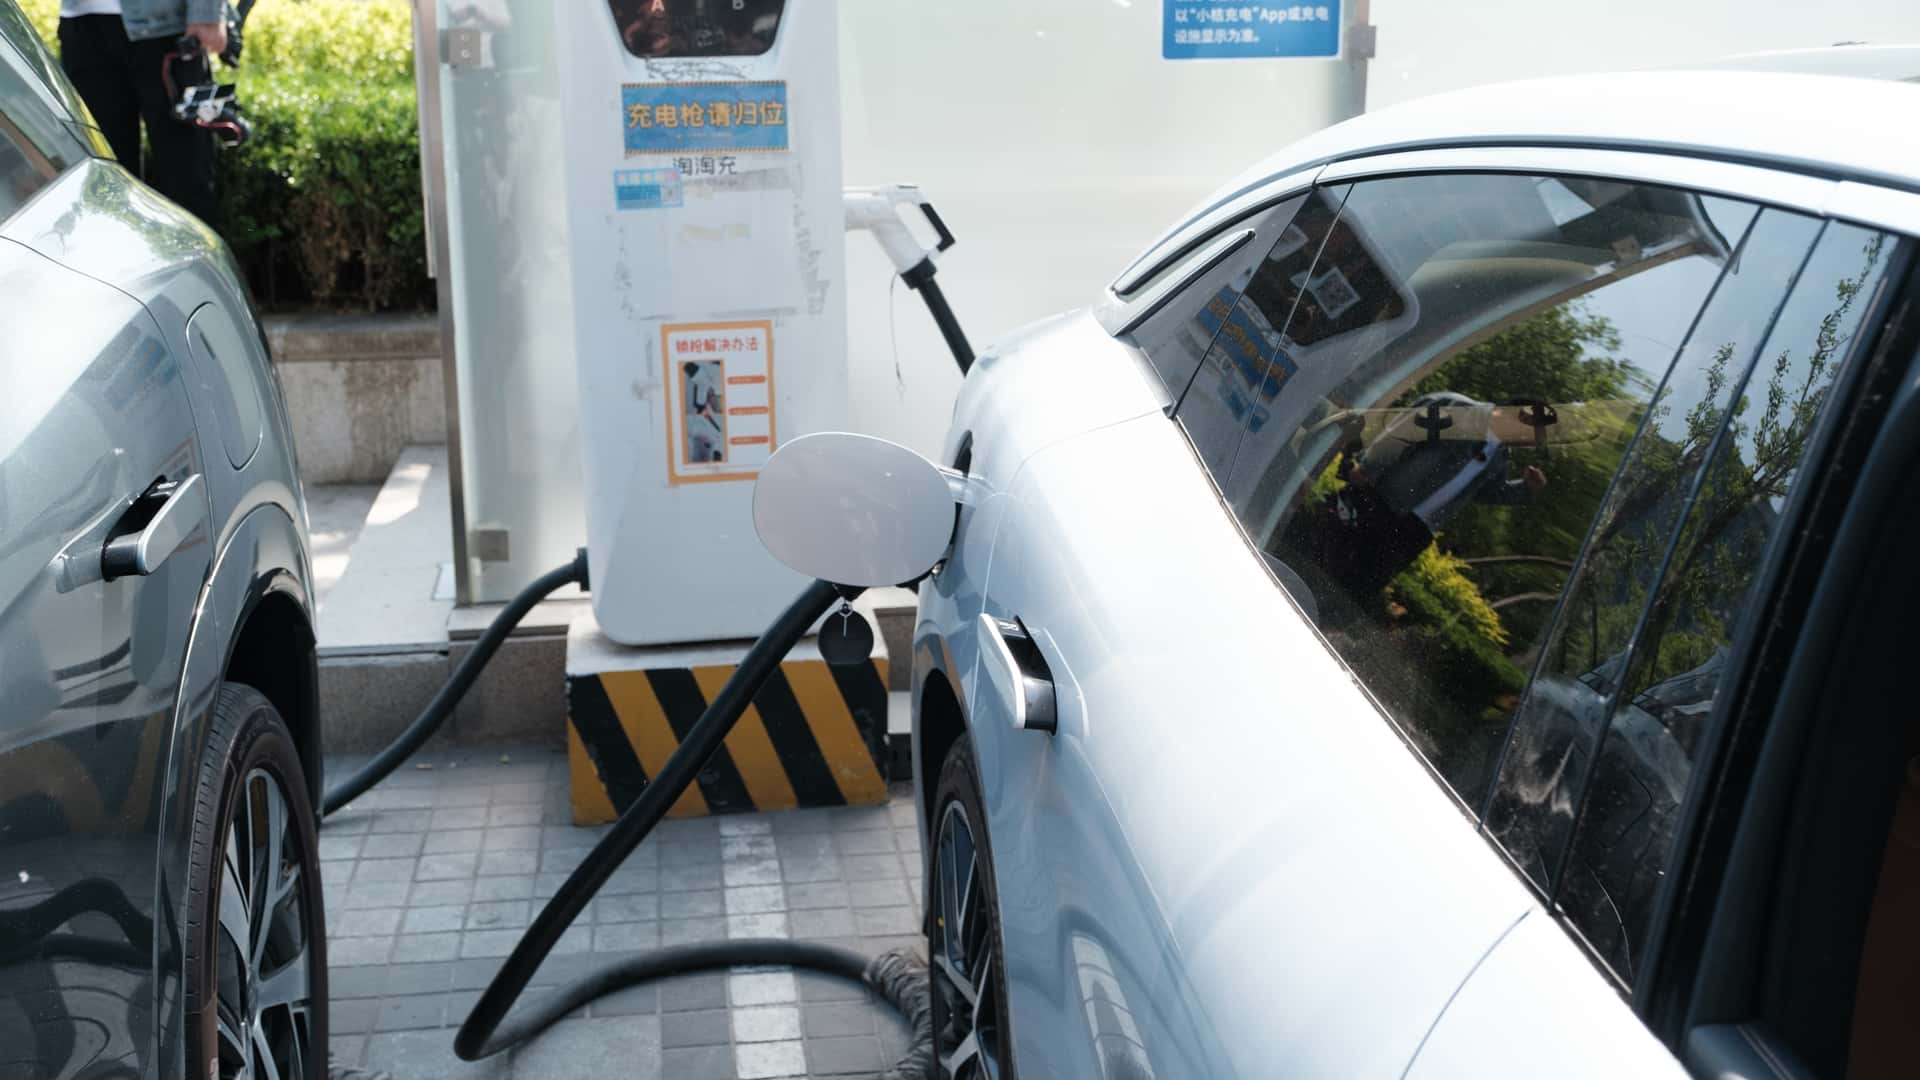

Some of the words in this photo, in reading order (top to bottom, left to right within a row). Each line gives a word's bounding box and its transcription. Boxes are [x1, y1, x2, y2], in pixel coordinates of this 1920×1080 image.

[651, 0, 665, 11] A
[732, 0, 745, 10] B
[627, 102, 785, 128] 充电枪请归位
[672, 156, 738, 176] 淘淘充
